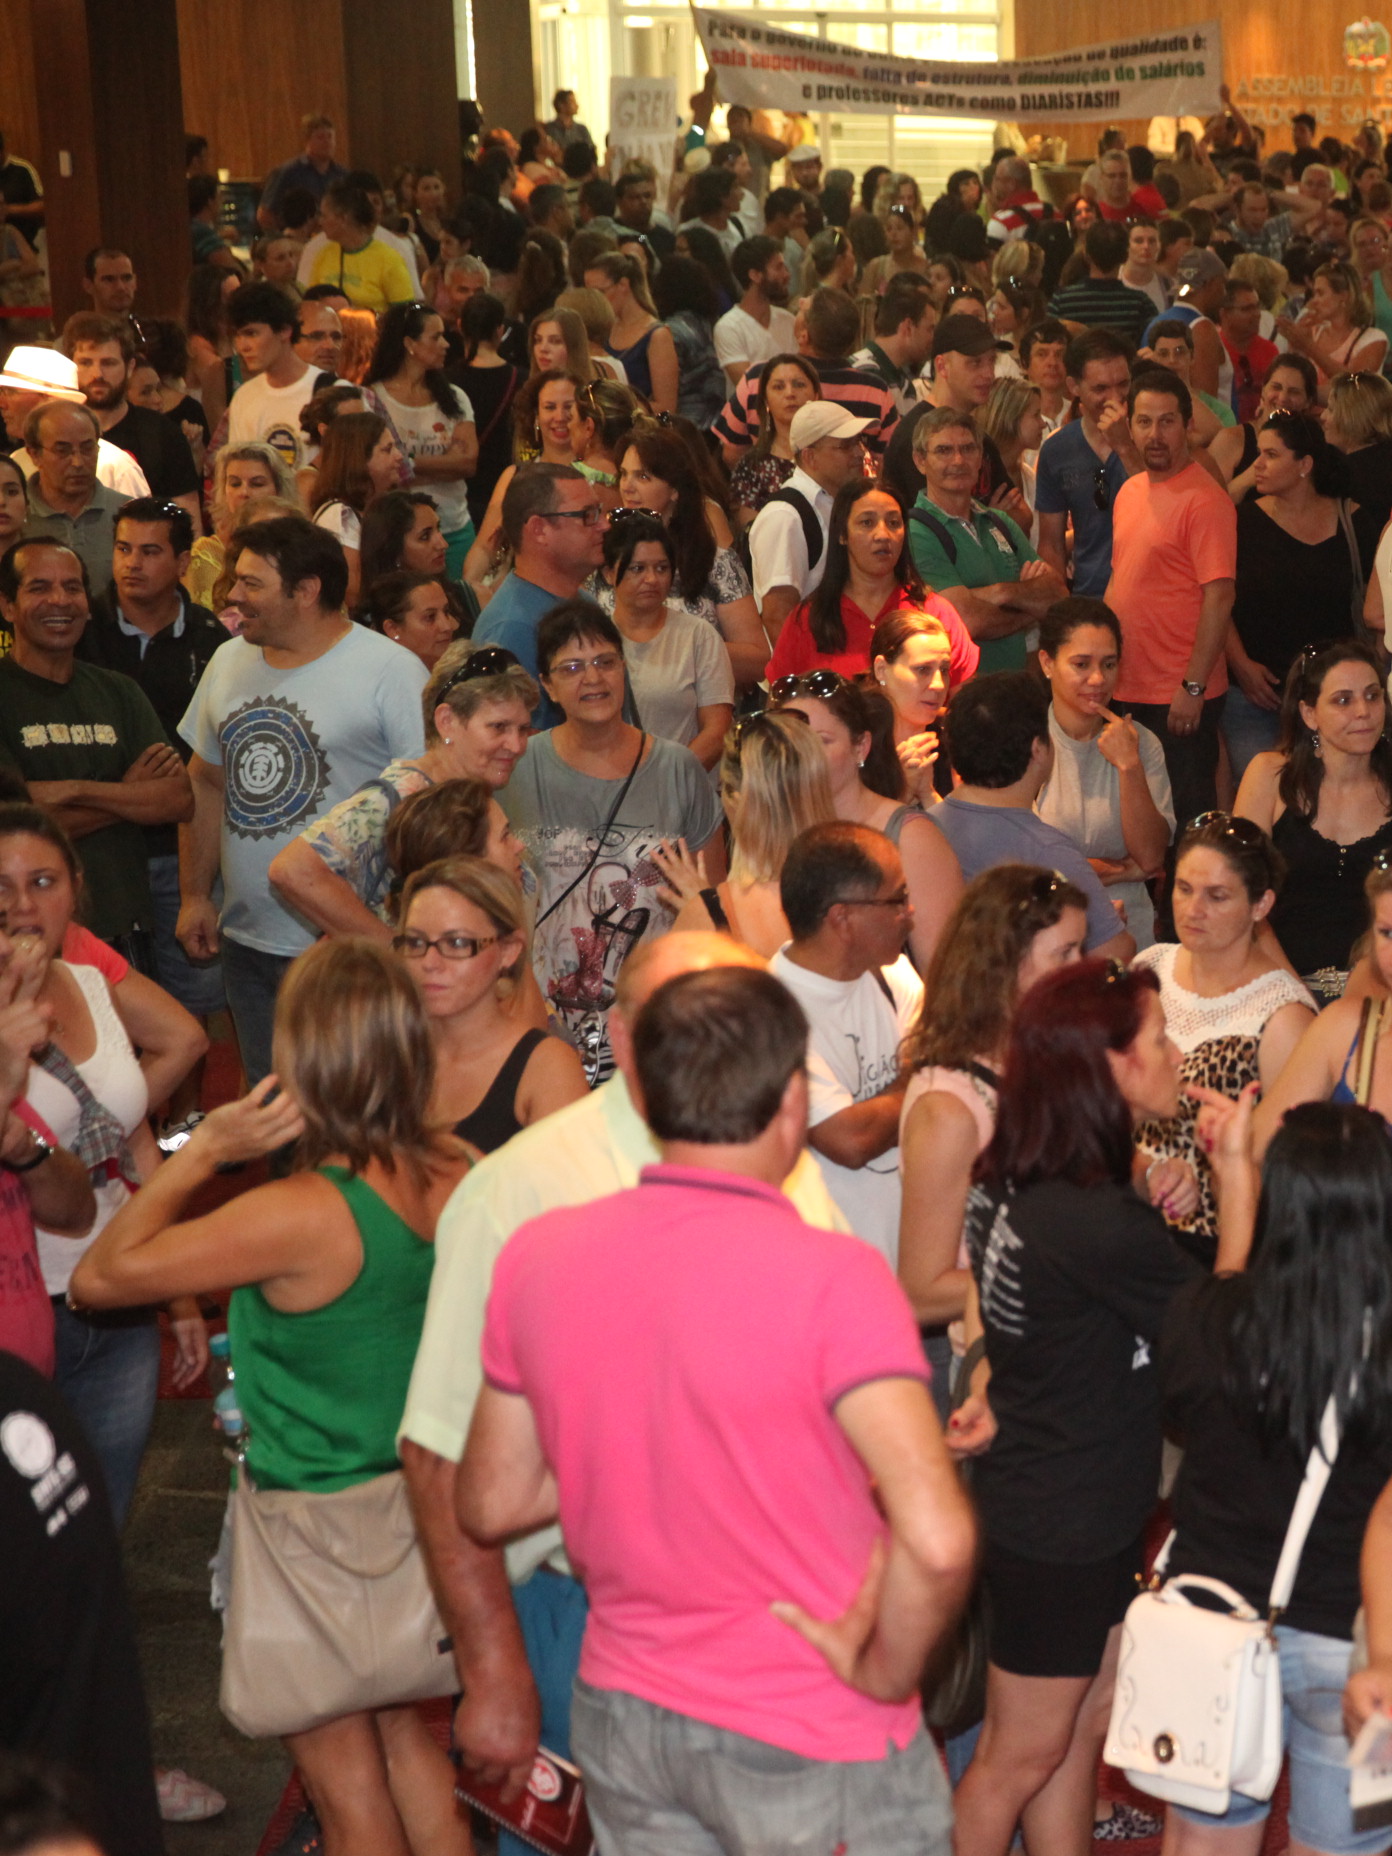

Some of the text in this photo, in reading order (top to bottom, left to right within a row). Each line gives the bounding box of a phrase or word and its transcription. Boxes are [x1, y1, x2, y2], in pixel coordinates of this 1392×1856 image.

[707, 19, 746, 40] Para
[750, 28, 761, 42] o
[766, 31, 837, 55] governo
[1109, 35, 1189, 60] qualidade
[711, 48, 747, 68] sala
[862, 66, 902, 85] falta
[906, 69, 927, 84] de
[931, 71, 1011, 86] estrutura,
[1017, 65, 1110, 87] diminuição
[1114, 64, 1135, 82] de
[1139, 59, 1205, 80] salários
[802, 84, 812, 99] e
[817, 84, 919, 106] professores
[969, 95, 1017, 112] como
[1236, 76, 1365, 97] ASSEMBLEIA
